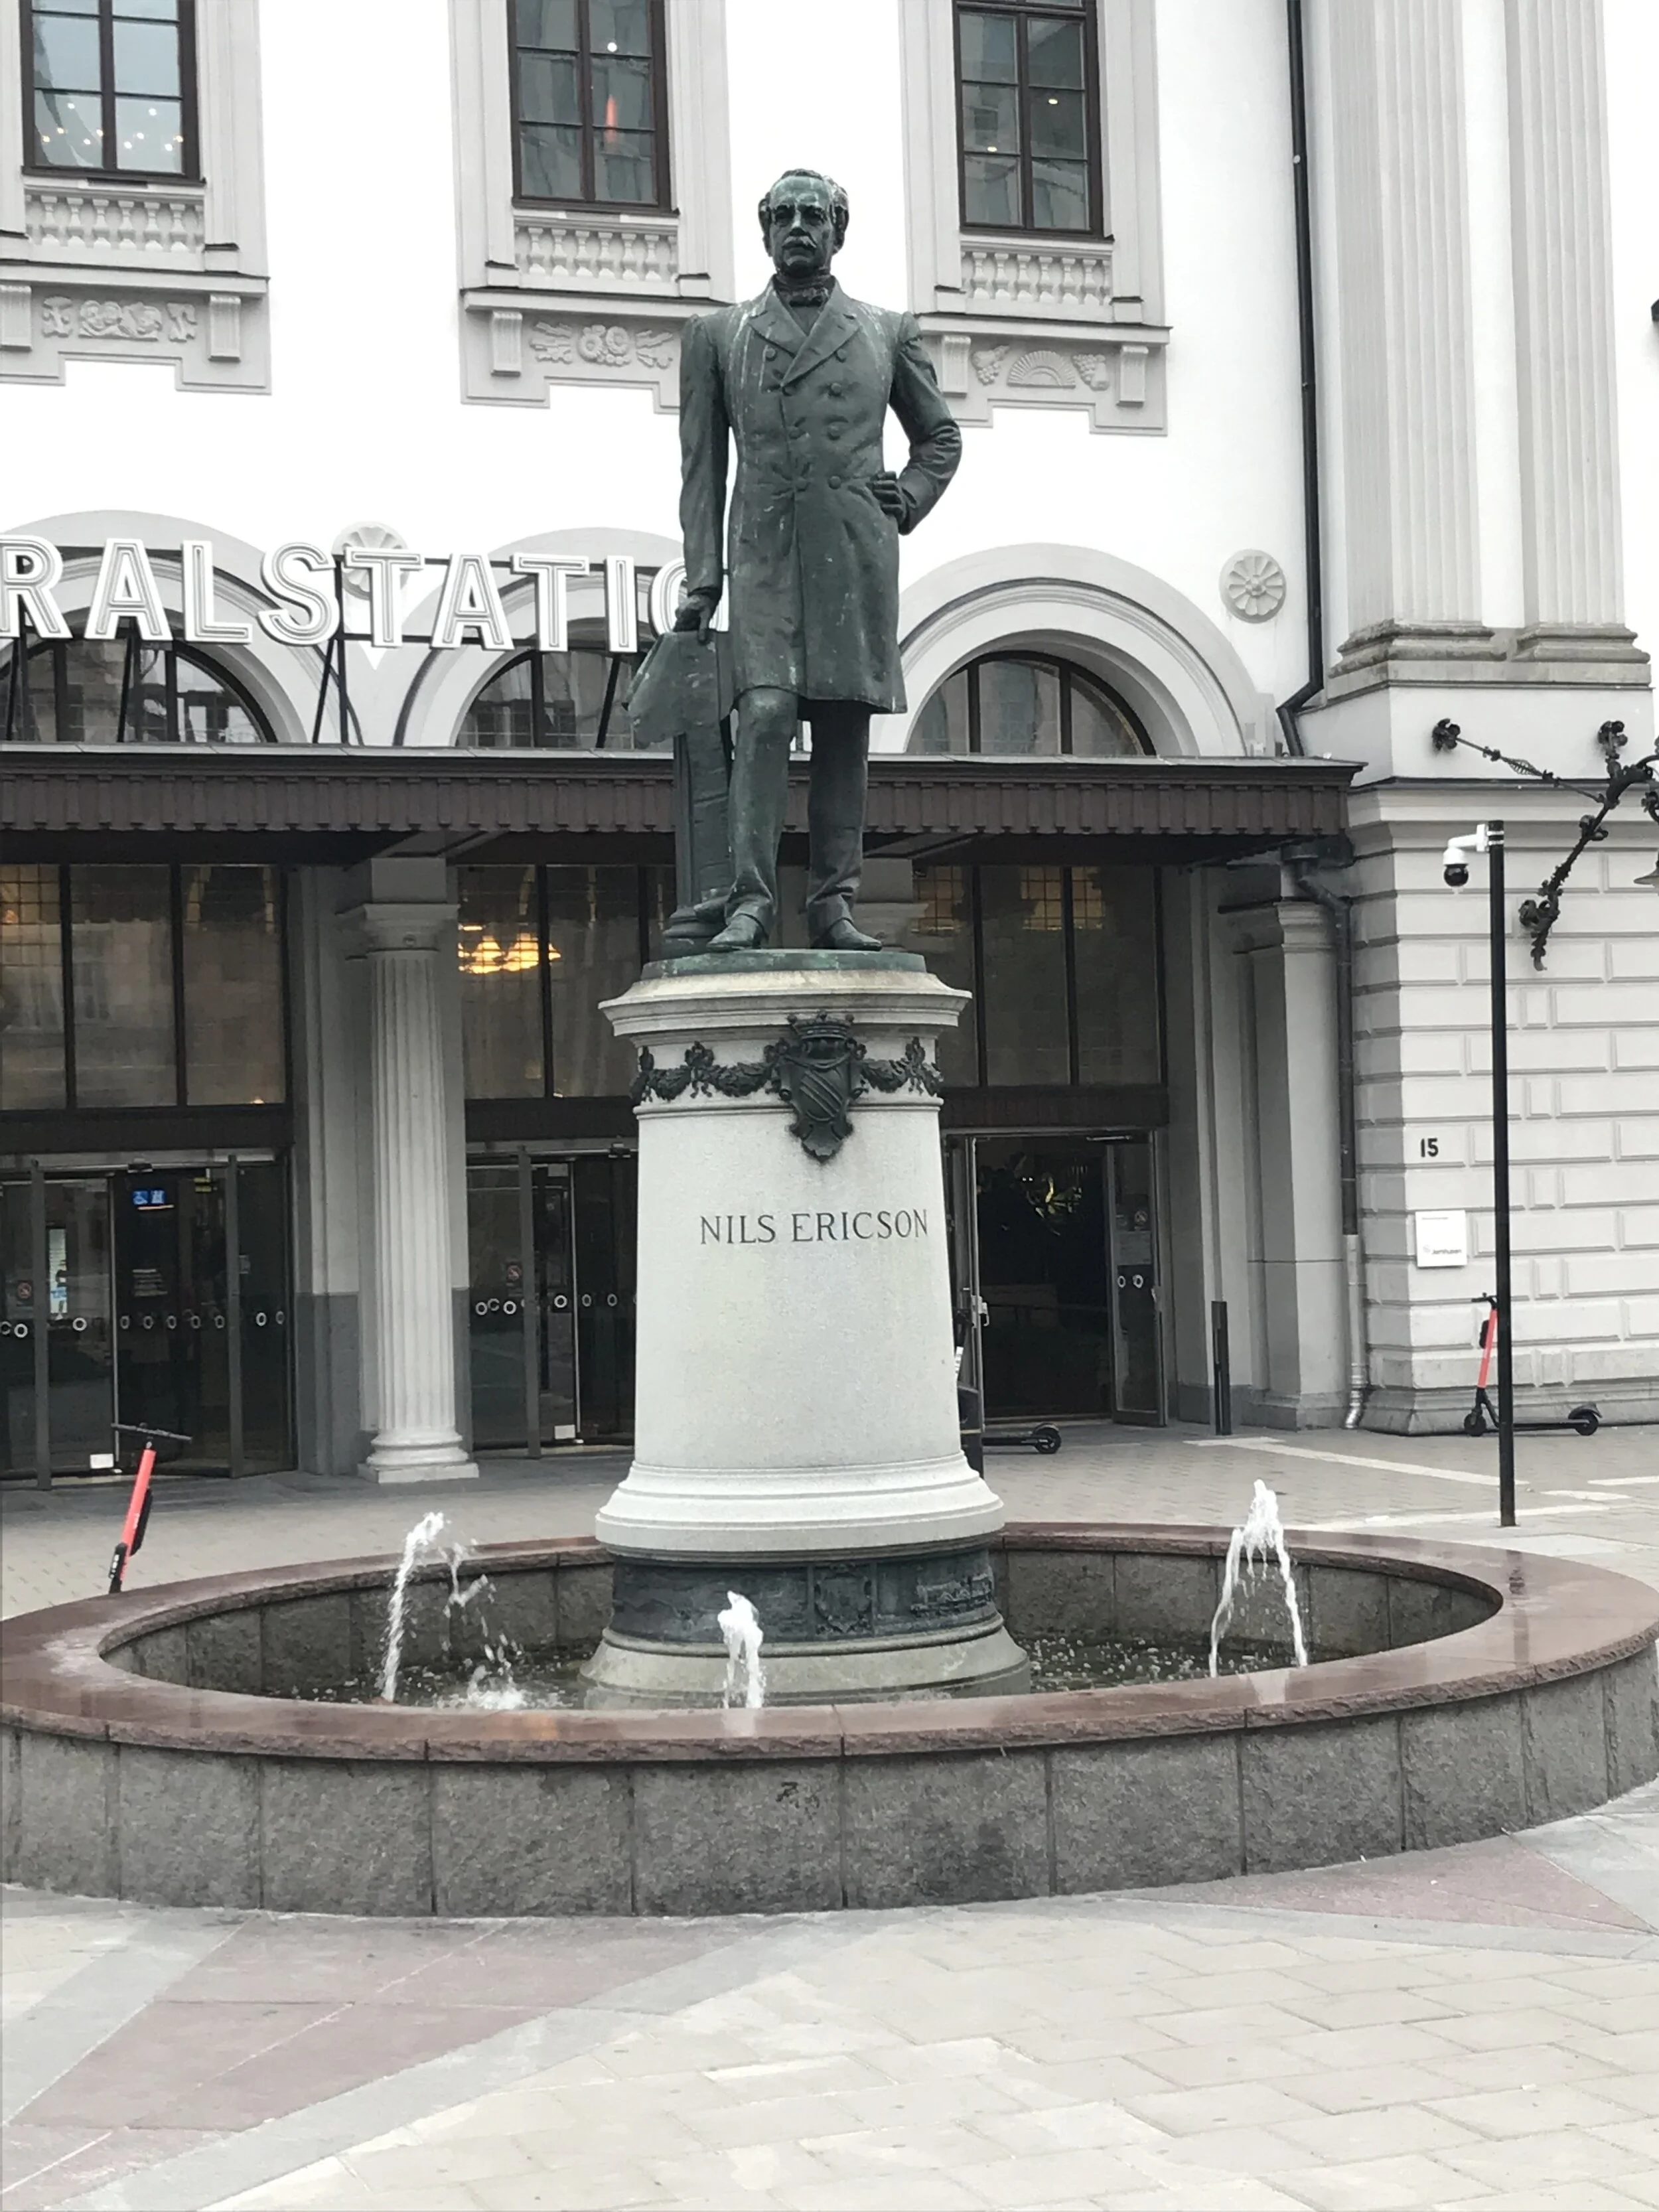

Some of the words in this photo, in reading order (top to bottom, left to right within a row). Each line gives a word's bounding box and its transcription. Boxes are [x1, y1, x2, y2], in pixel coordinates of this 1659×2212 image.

[1420, 1138, 1439, 1157] 15
[700, 1214, 776, 1244] NILS
[792, 1208, 928, 1242] ERICSON
